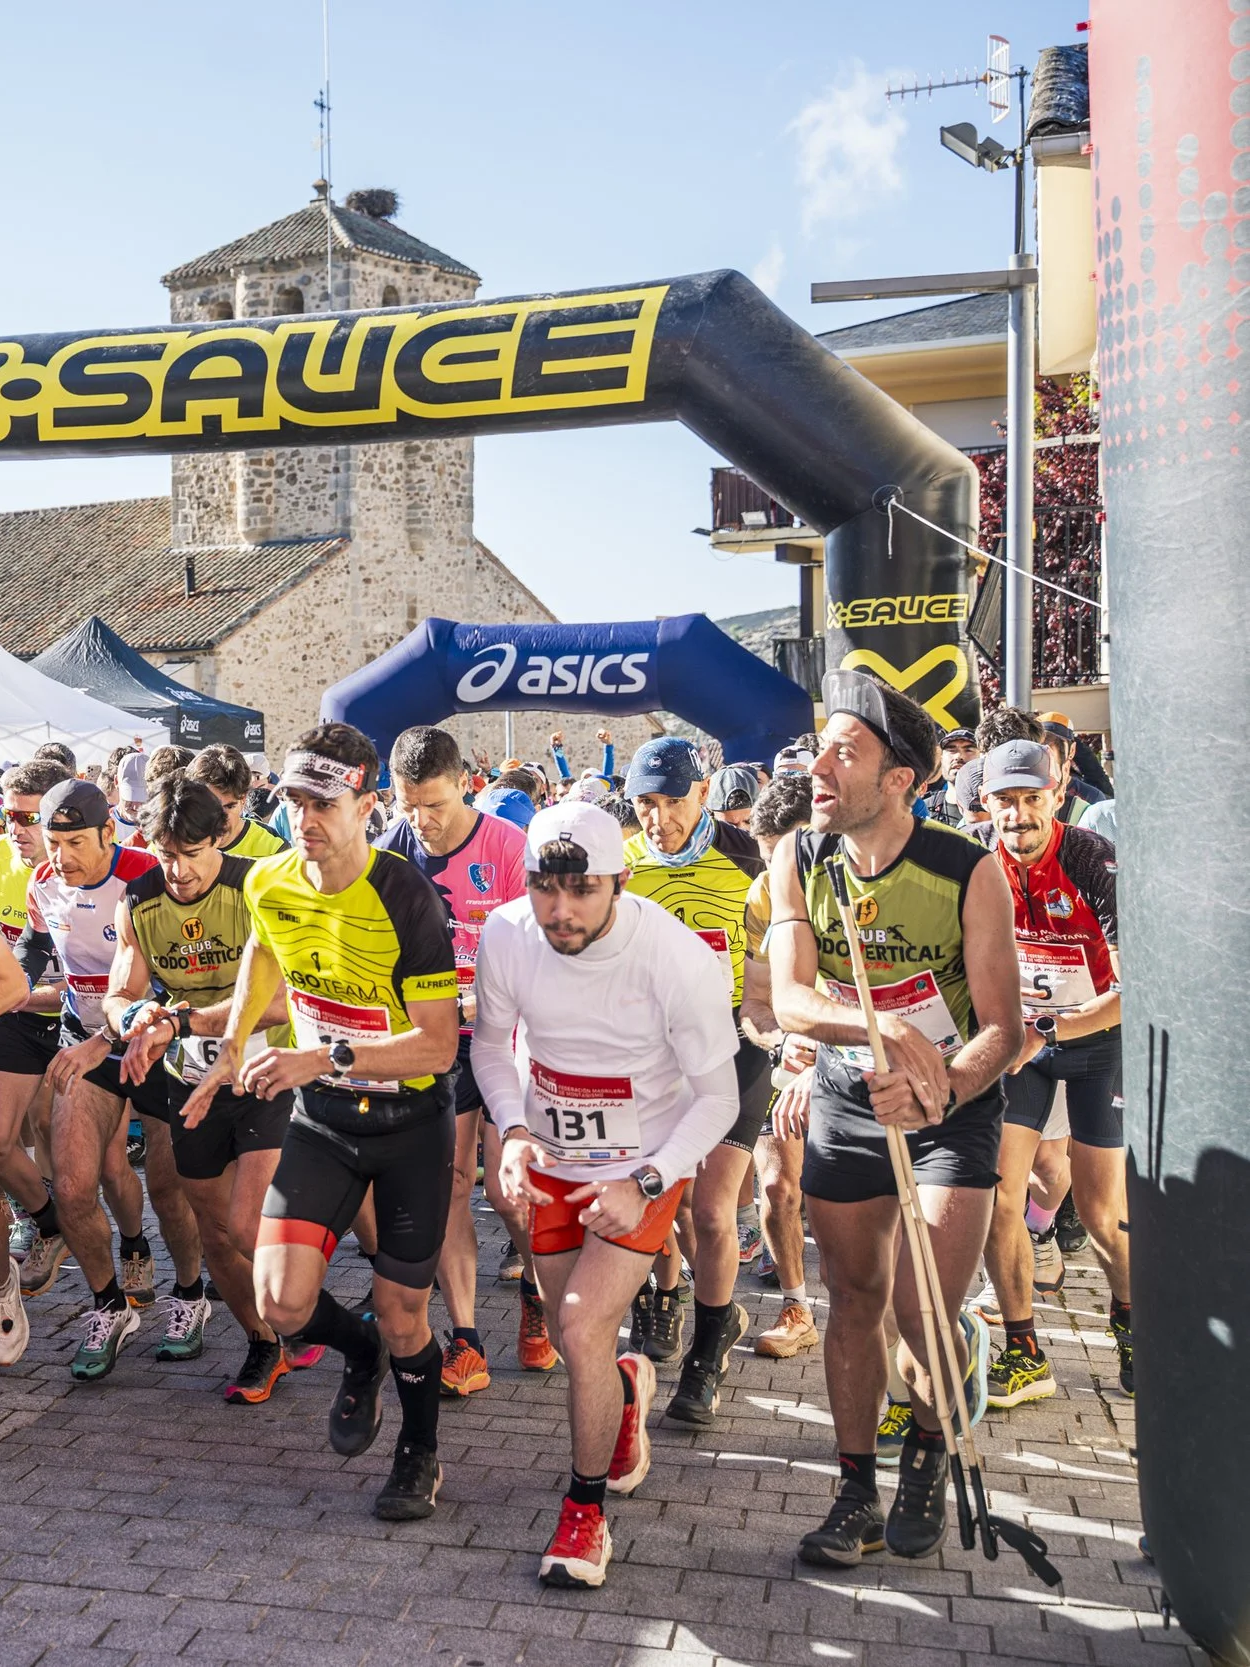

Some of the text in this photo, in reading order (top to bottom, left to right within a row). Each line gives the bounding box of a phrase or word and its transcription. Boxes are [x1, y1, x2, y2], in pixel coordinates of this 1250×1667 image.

[320, 763, 346, 775] BIG
[180, 940, 212, 956] CLUB
[153, 945, 245, 970] TODOVERTICA
[74, 980, 96, 993] fmm
[298, 998, 321, 1020] fmm
[339, 1029, 380, 1040] montaña
[538, 1070, 558, 1094] fmm
[558, 1085, 591, 1094] FEDERACIÓN
[565, 1099, 575, 1107] la
[577, 1100, 625, 1108] montaña
[545, 1106, 606, 1141] 131
